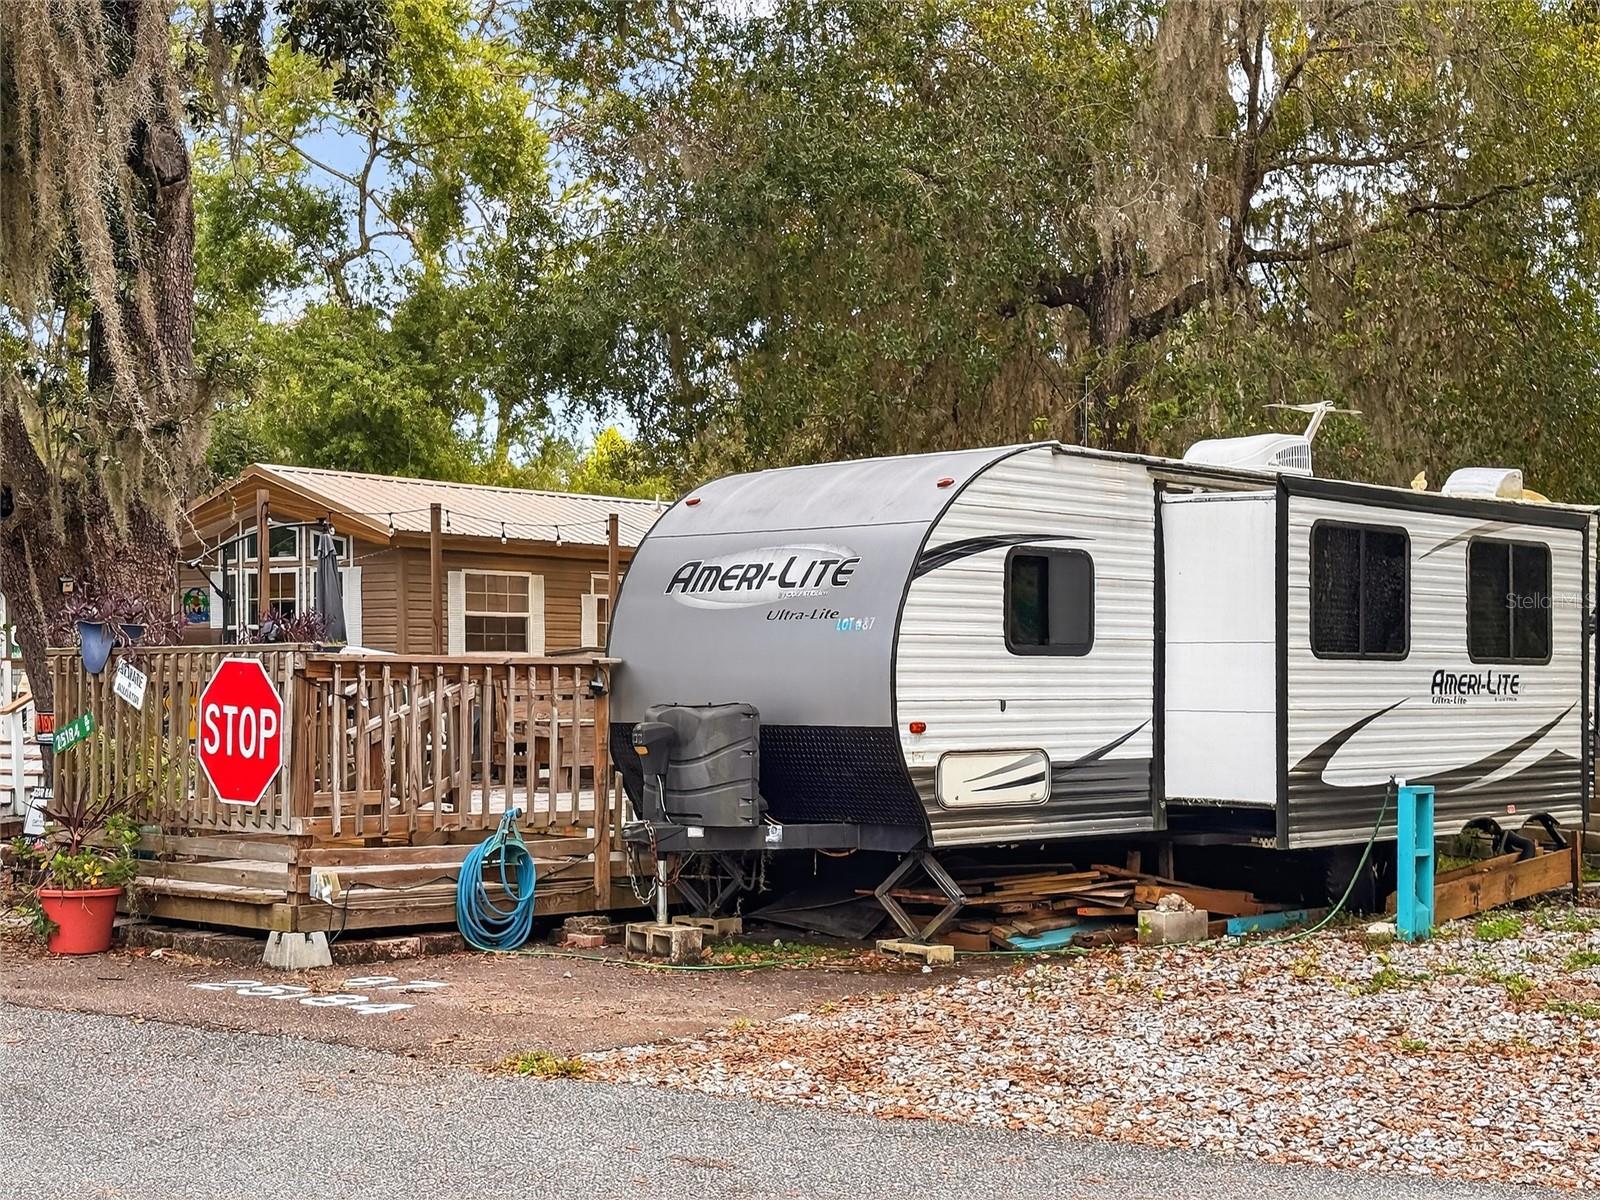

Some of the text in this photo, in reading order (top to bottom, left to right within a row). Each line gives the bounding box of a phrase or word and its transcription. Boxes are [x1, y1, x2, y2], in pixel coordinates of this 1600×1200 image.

[664, 555, 862, 595] AMERI-LITE
[766, 608, 840, 622] Ultra-Lite
[836, 618, 854, 631] LOT
[1431, 669, 1520, 695] AMERI-LITE
[1432, 695, 1468, 705] Ultra-Lite
[203, 703, 278, 760] STOP
